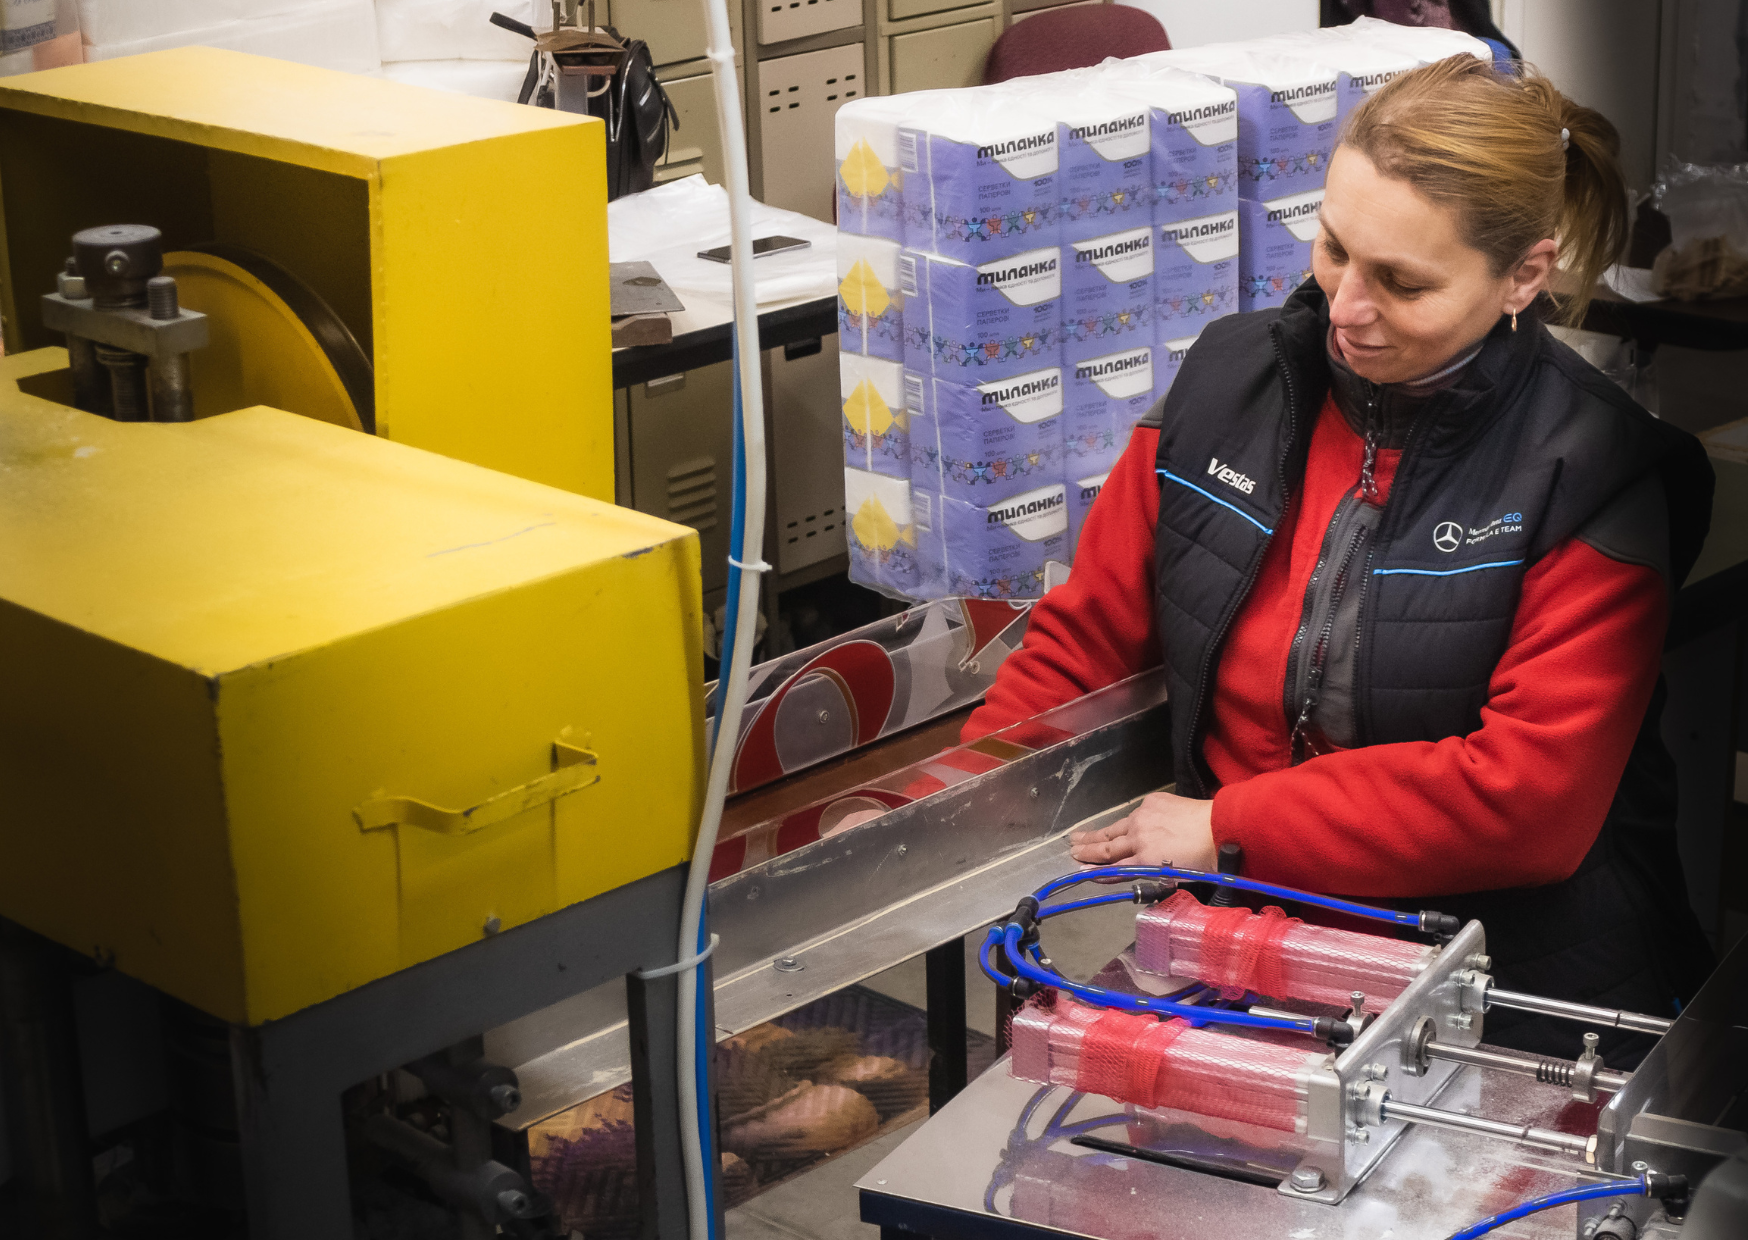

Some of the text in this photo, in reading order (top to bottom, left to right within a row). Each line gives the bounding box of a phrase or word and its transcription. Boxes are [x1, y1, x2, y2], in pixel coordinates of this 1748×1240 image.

[1267, 199, 1323, 222] милан
[1207, 457, 1256, 495] Vestas
[1503, 512, 1523, 523] EQ
[1500, 525, 1523, 534] TEAM
